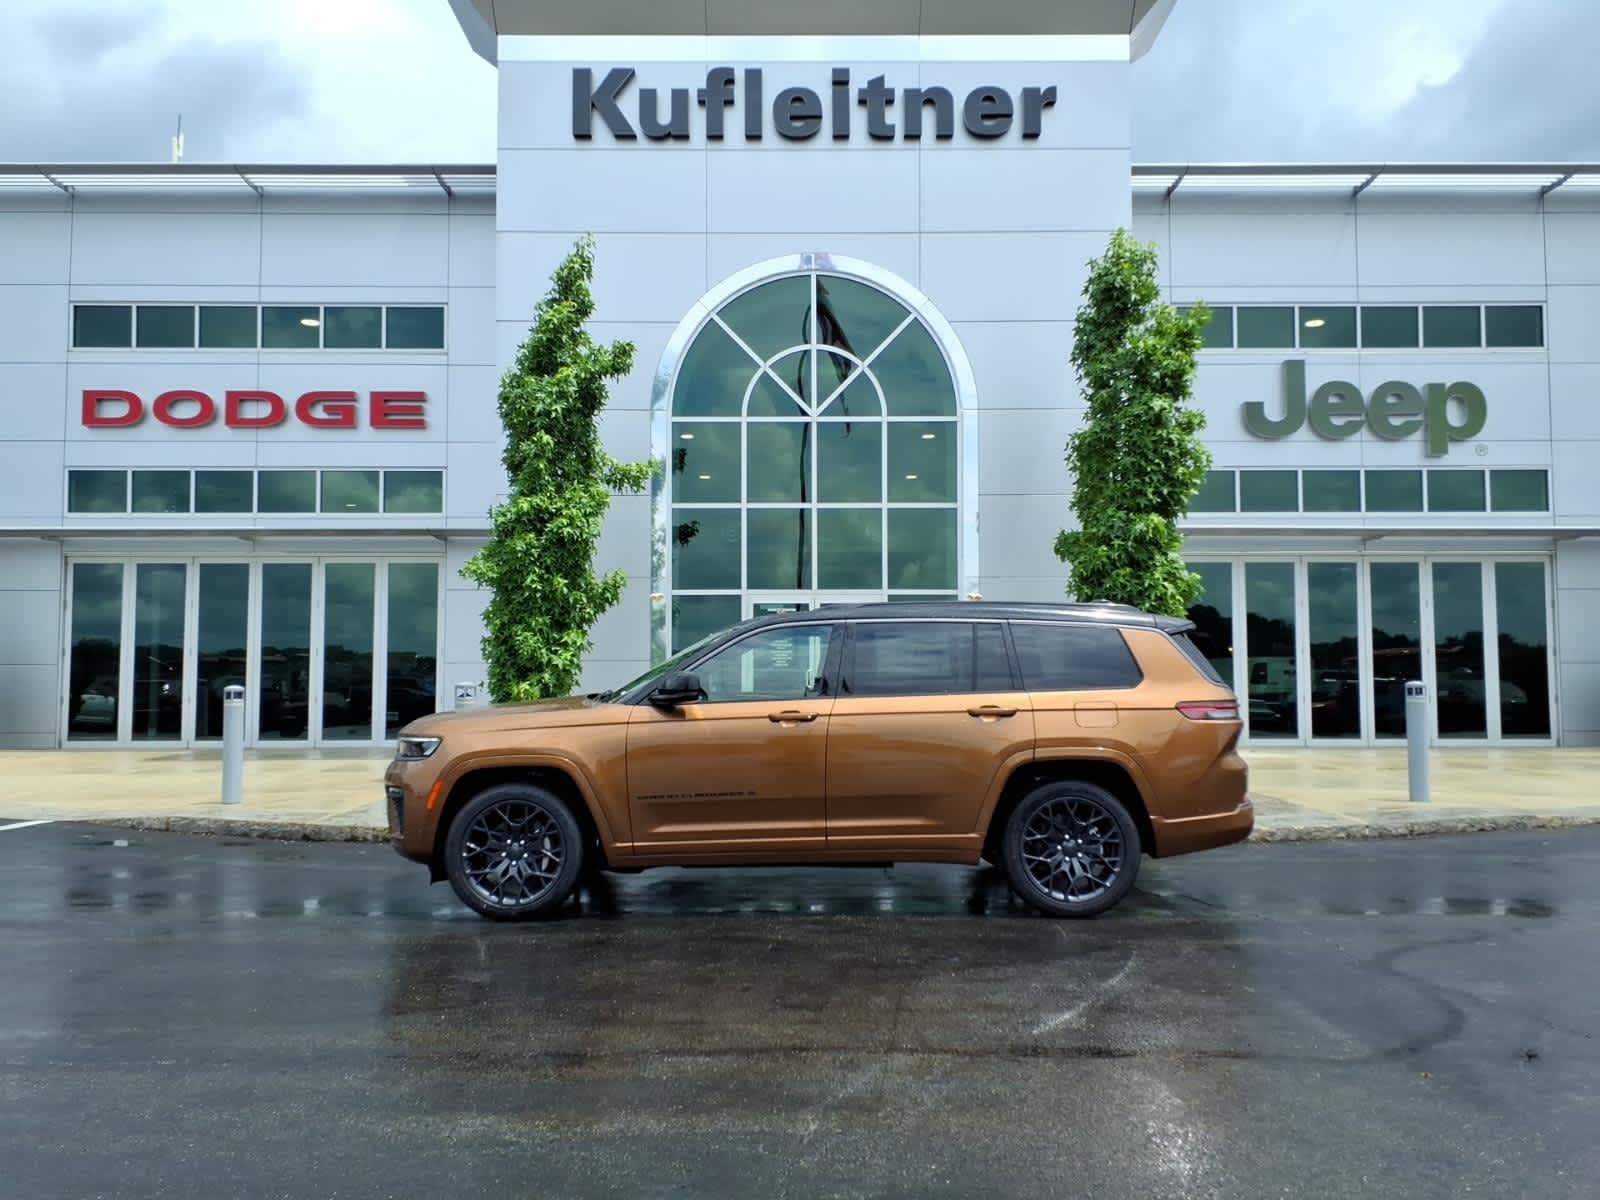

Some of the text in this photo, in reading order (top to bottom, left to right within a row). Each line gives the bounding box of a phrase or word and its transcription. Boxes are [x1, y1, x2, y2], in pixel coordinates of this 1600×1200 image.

[572, 67, 1057, 140] Kufleitner
[81, 389, 427, 429] DODGE
[1241, 359, 1487, 457] Jeep
